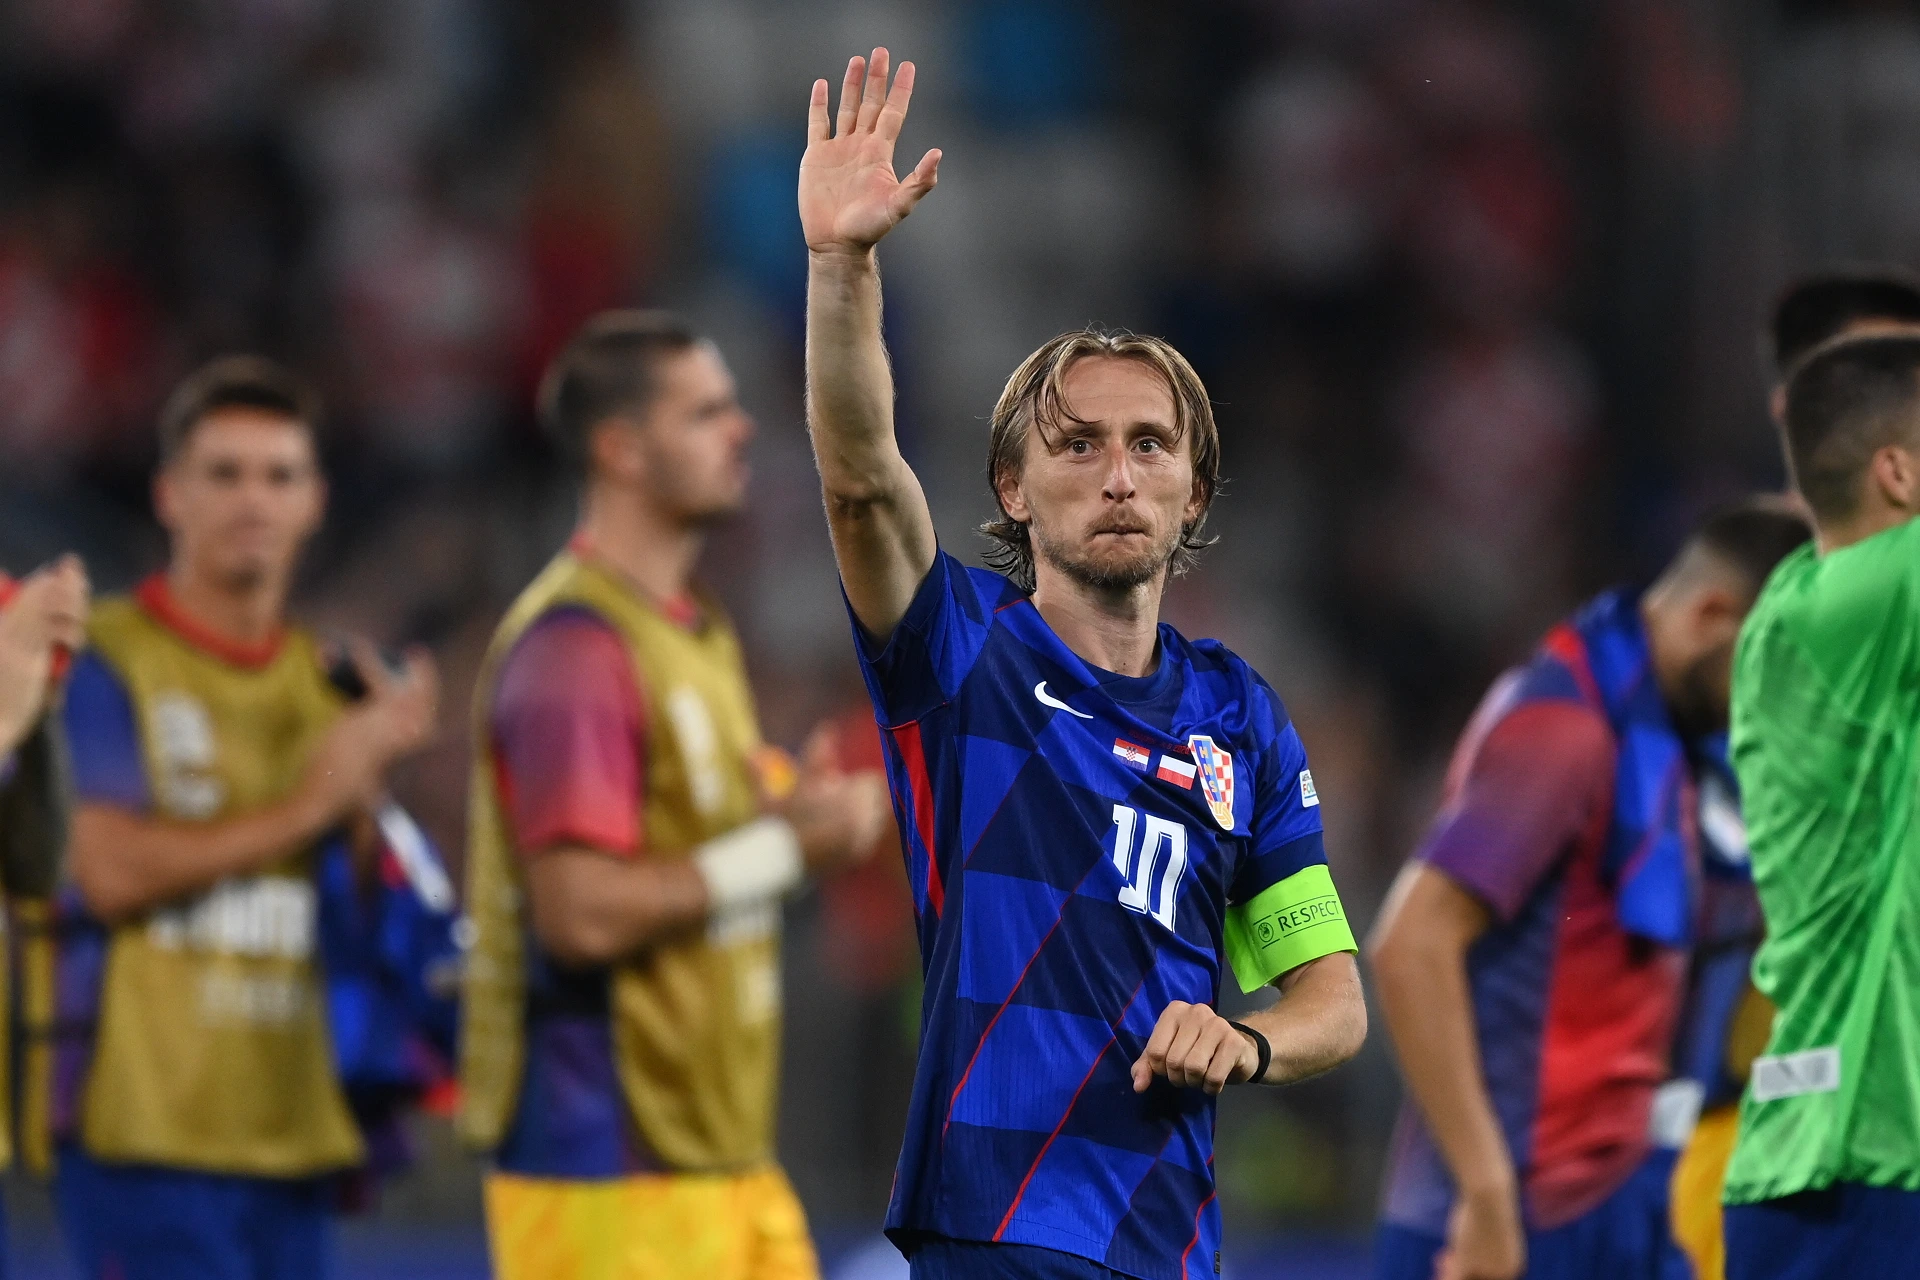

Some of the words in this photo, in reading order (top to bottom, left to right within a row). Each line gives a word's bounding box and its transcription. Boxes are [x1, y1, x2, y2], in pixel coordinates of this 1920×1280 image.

[1199, 746, 1218, 793] HNS
[1112, 804, 1188, 934] 10
[1277, 900, 1339, 932] RESPECT
